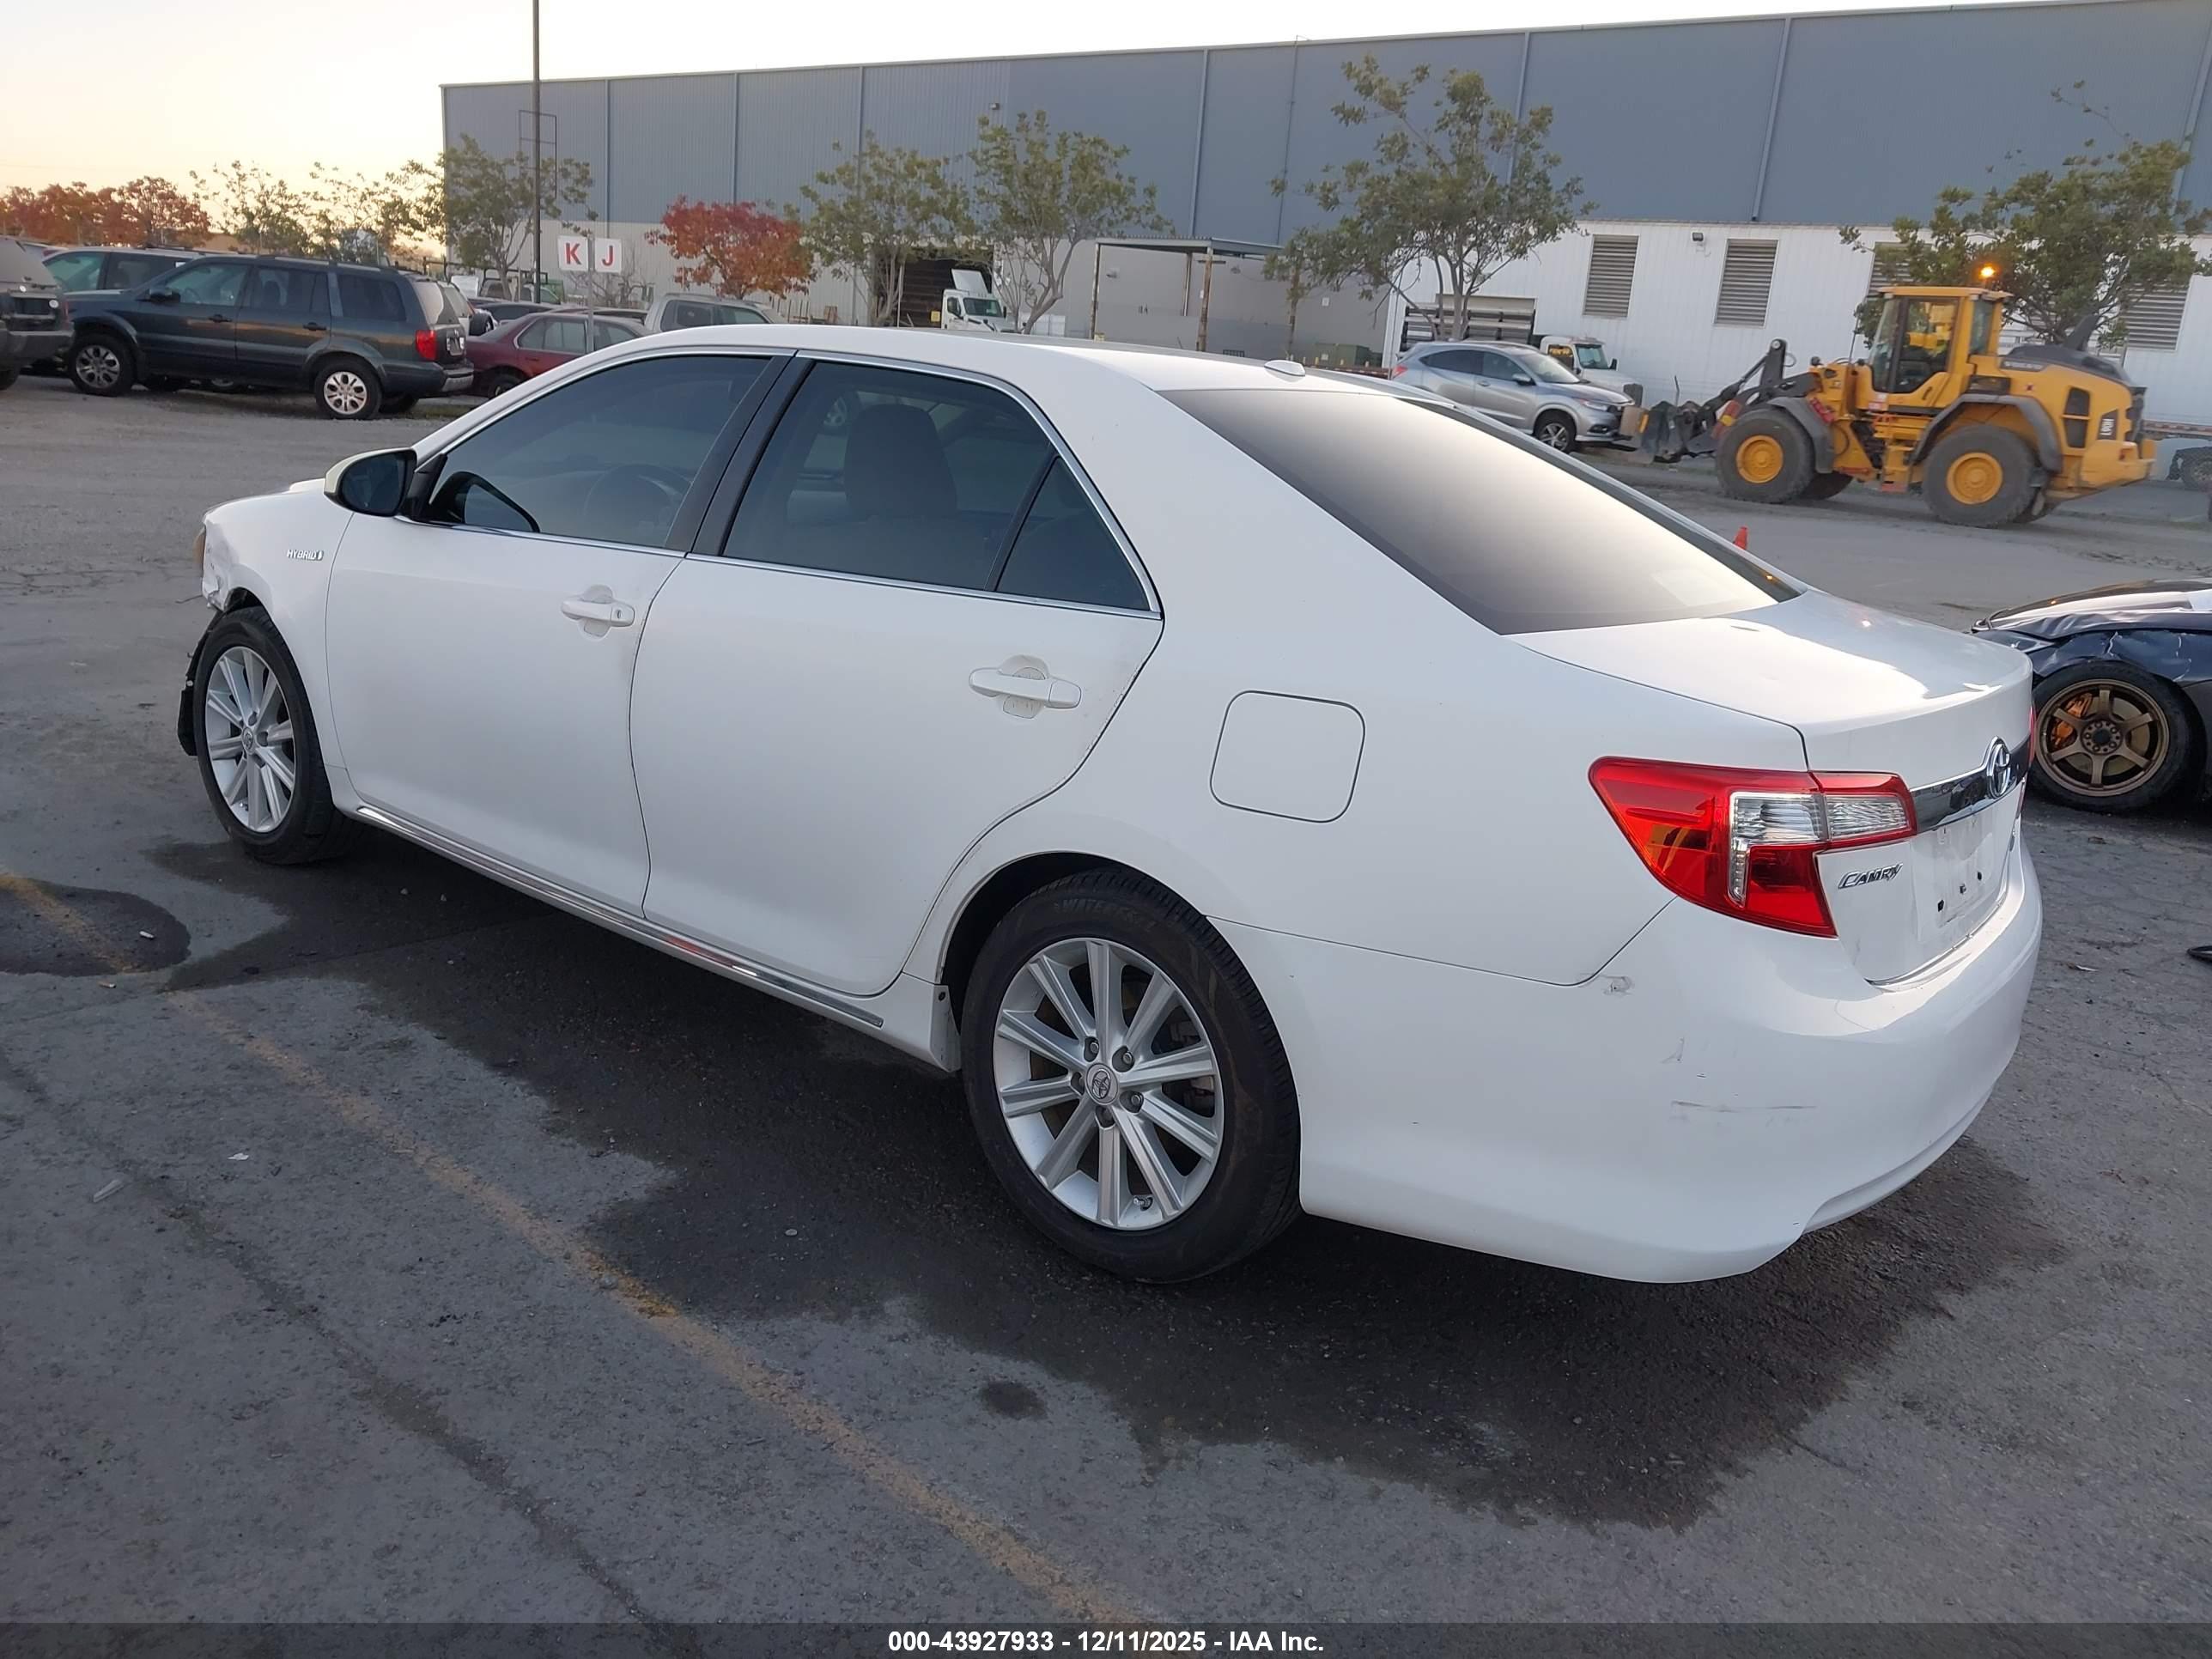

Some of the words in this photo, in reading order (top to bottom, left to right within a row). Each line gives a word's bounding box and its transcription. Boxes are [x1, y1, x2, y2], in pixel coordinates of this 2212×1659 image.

[565, 242, 582, 265] K
[601, 245, 614, 267] J
[287, 549, 318, 561] HYBRID
[1838, 862, 1904, 890] CAMRY
